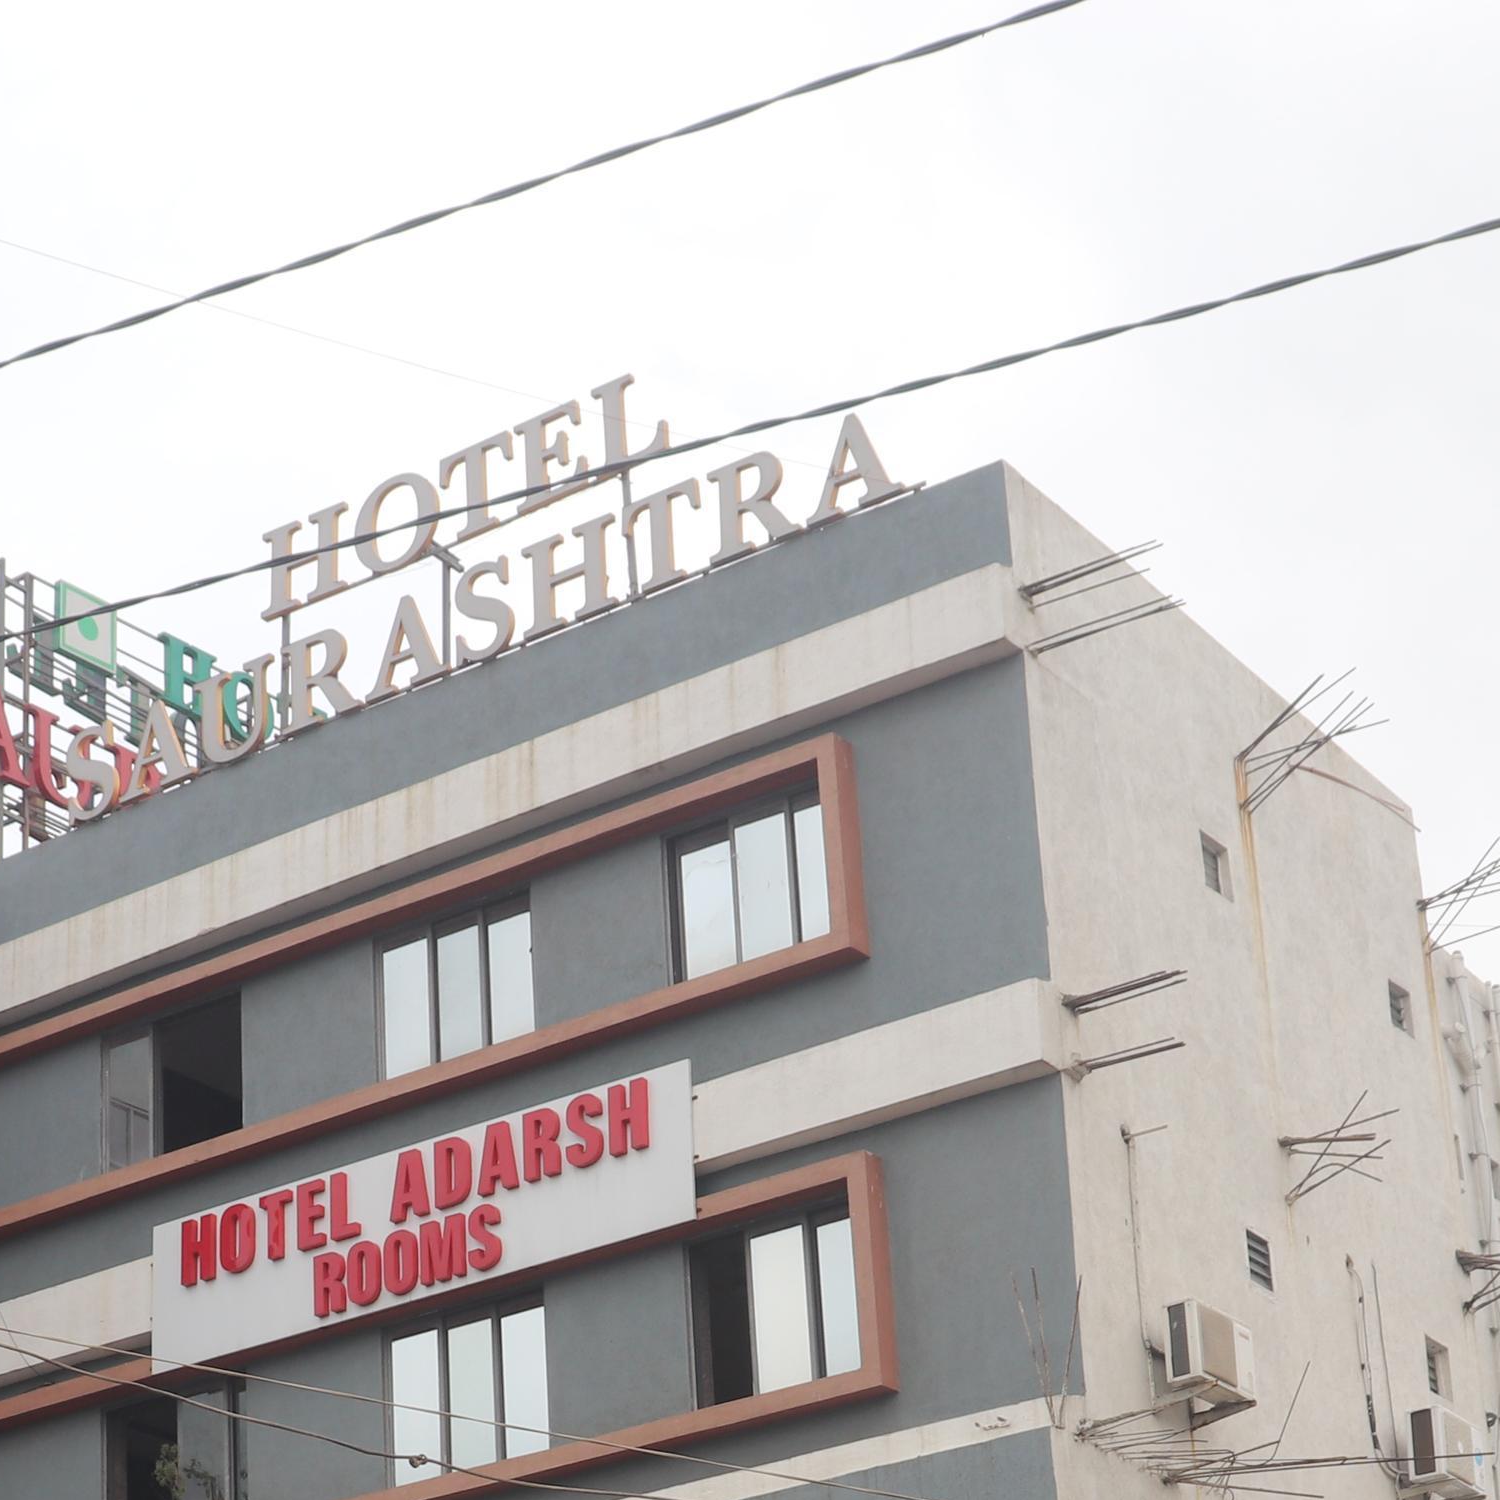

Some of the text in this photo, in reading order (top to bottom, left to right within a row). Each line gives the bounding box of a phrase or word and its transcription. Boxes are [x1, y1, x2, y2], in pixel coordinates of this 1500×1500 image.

[261, 373, 669, 621] HOTEL
[65, 414, 903, 825] SAURASHTRA
[180, 1077, 649, 1287] HOTEL ADARSH
[313, 1203, 502, 1318] ROOMS
